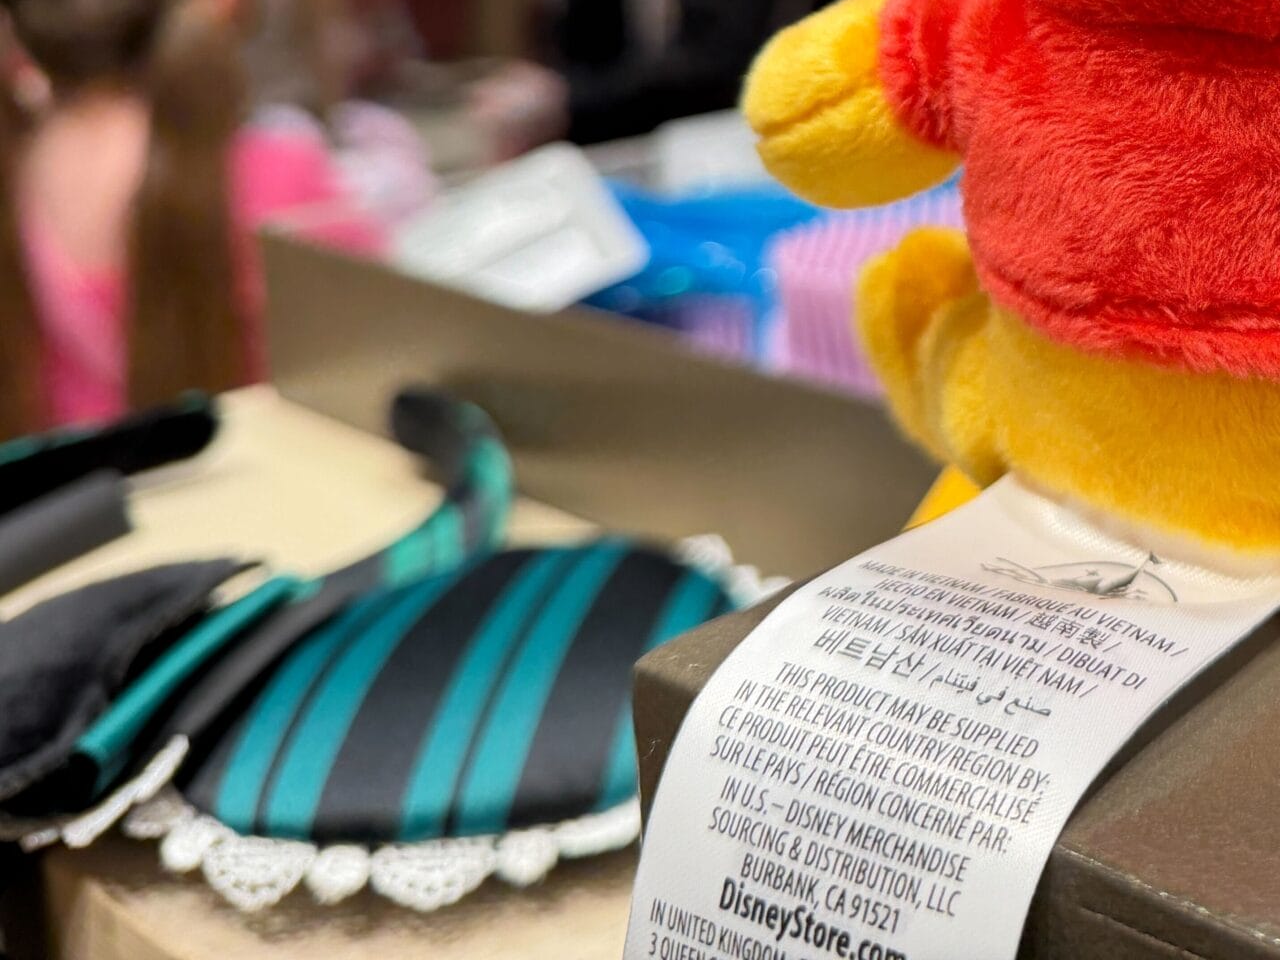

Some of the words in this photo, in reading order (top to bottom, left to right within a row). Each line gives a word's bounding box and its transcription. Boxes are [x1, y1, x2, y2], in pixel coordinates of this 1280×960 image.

[813, 628, 926, 679] 베트남산
[918, 662, 942, 682] /
[822, 604, 891, 637] VIETNAM
[884, 622, 900, 637] /
[1037, 667, 1085, 695] NAM
[1079, 684, 1099, 698] /
[859, 559, 904, 577] MADE
[900, 568, 919, 580] IN
[918, 572, 987, 594] VIETNAM
[1067, 606, 1099, 620] AU
[1097, 613, 1177, 653] VIETNAM
[1171, 647, 1189, 657] /
[873, 578, 928, 597] HECHO
[923, 589, 949, 603] EN
[952, 592, 1020, 620] VIETNAM
[1024, 612, 1112, 650] 越南製
[775, 661, 816, 689] THIS
[809, 672, 892, 713] PRODUCT
[885, 695, 932, 726] MAY
[926, 708, 957, 734] BE
[950, 717, 1040, 759] SUPPLIED
[1056, 646, 1126, 682] DIBUAT
[1122, 672, 1147, 690] DI
[718, 704, 743, 730] CE
[738, 711, 813, 754] PRODUIT
[805, 734, 855, 768] PEUT
[849, 744, 896, 782] ÊTRE
[892, 761, 1041, 825] COMMERCIALISÉ
[734, 678, 759, 703] IN
[754, 684, 790, 713] THE
[784, 693, 872, 738] RELEVANT
[867, 720, 1021, 786] COUNTRY/REGION
[1017, 766, 1051, 795] BY:
[709, 734, 746, 766] SUR
[742, 744, 767, 773] LE
[762, 751, 807, 786] PAYS
[799, 766, 818, 790] /
[813, 769, 881, 812] RÉGION
[878, 790, 972, 841] CONCERNÉ
[968, 819, 1013, 854] PAR:
[719, 775, 743, 804] IN
[740, 782, 770, 816] U.S.
[784, 797, 849, 841] DISNEY
[845, 818, 972, 883] MERCHANDISE
[707, 805, 790, 857] SOURCING
[788, 835, 803, 862] &
[803, 840, 923, 911] DISTRIBUTION,
[925, 882, 963, 918] LLC
[740, 852, 821, 910] BURBANK,
[824, 883, 848, 916] CA
[849, 892, 902, 935] 91521
[648, 931, 658, 956] 3
[649, 897, 668, 927] IN
[666, 904, 717, 947] UNITED
